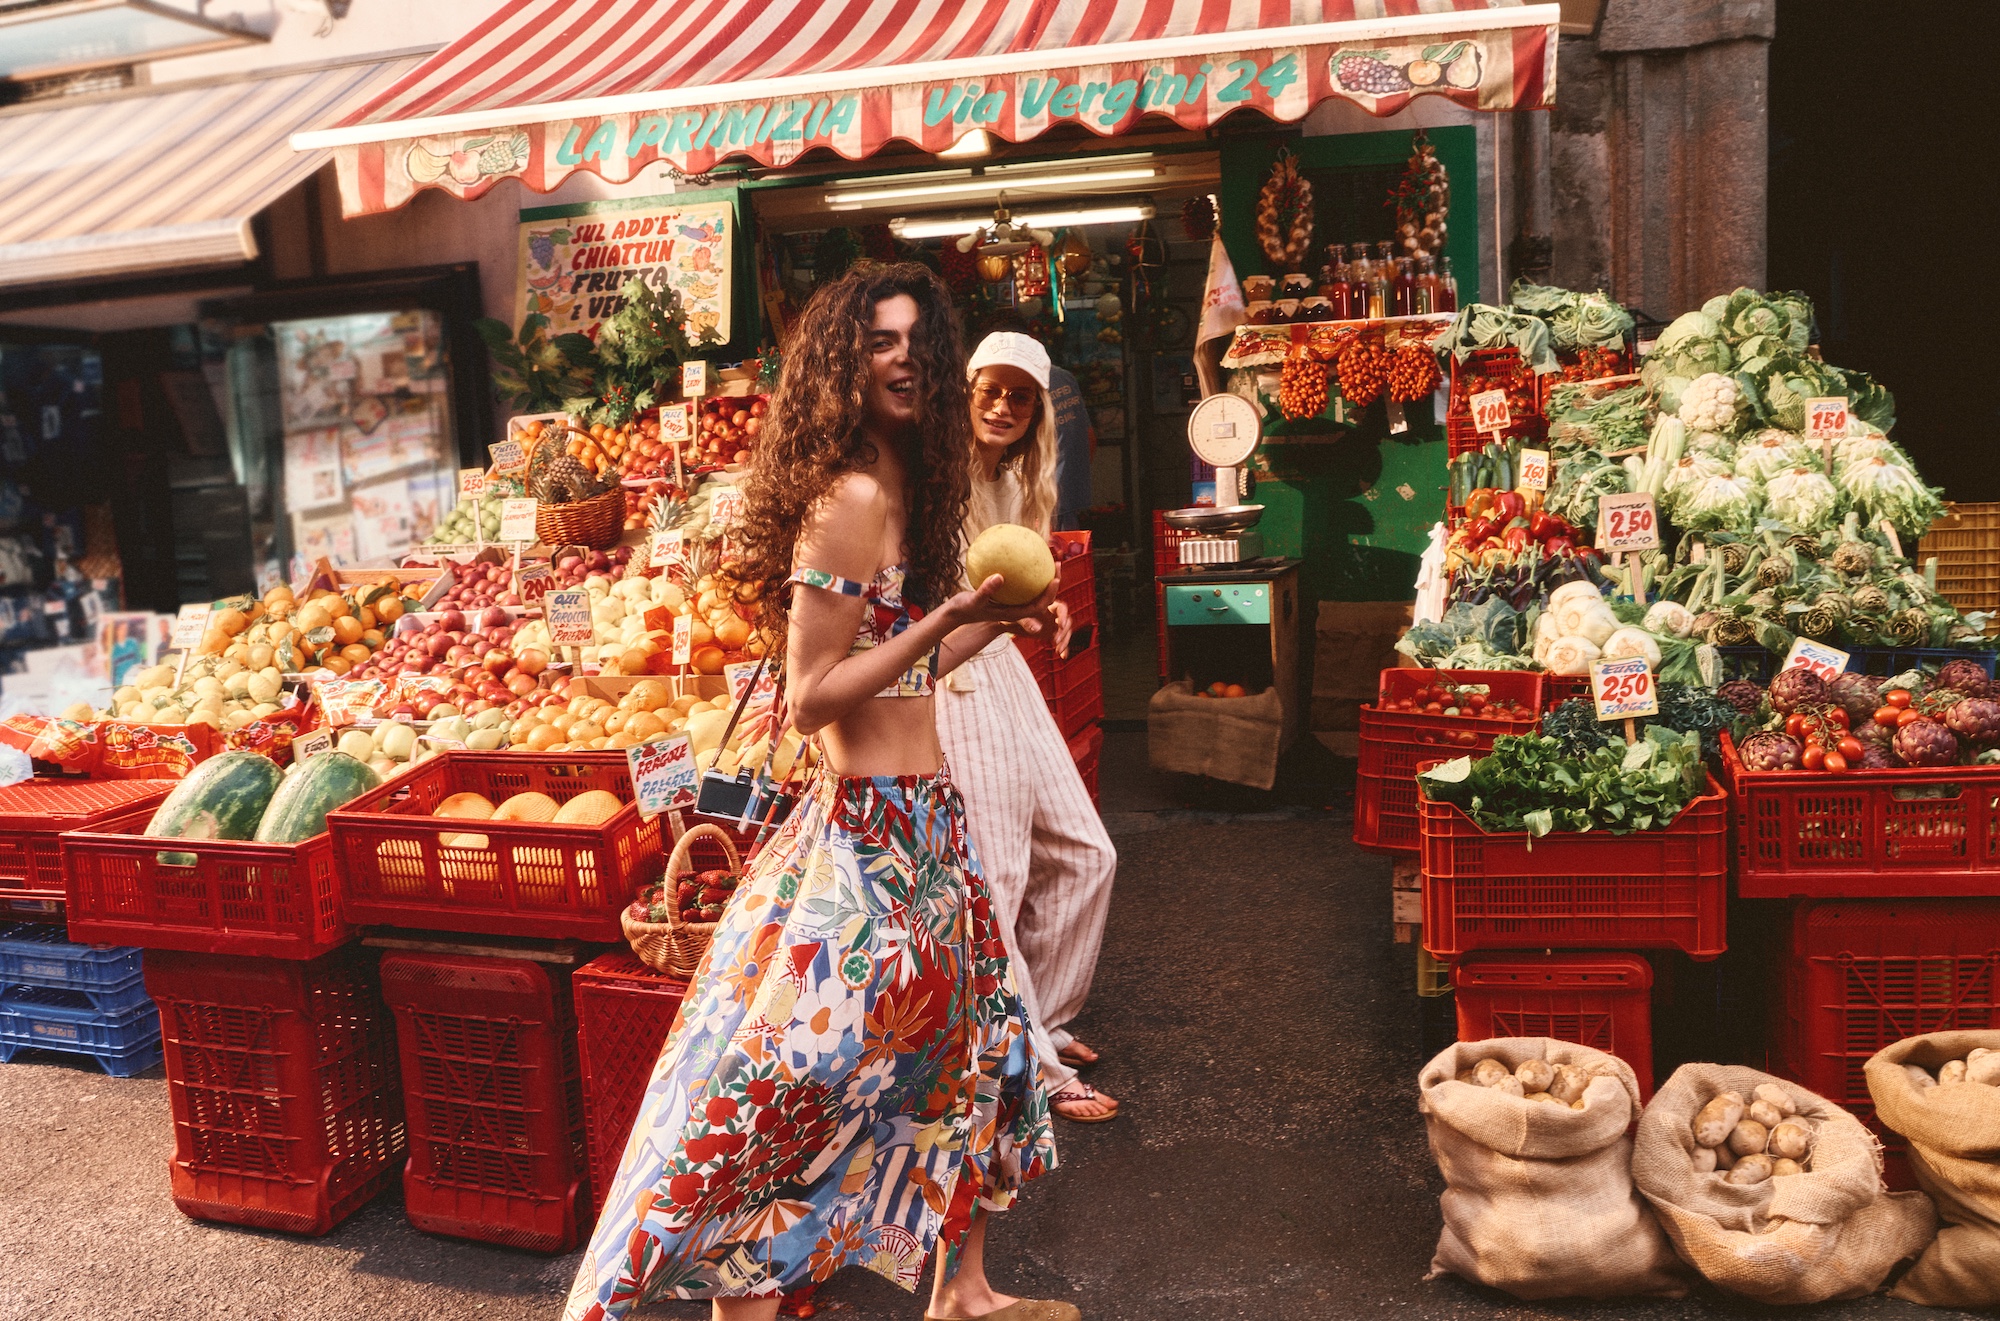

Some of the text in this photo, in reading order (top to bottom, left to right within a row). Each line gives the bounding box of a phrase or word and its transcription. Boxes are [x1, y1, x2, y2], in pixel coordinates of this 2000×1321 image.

[924, 53, 1298, 127] Via Vergini 24
[556, 94, 858, 165] LA PRIMIZIA
[571, 240, 675, 271] CHIATTUN
[1601, 660, 1648, 674] EURO
[1600, 673, 1648, 704] 2,50
